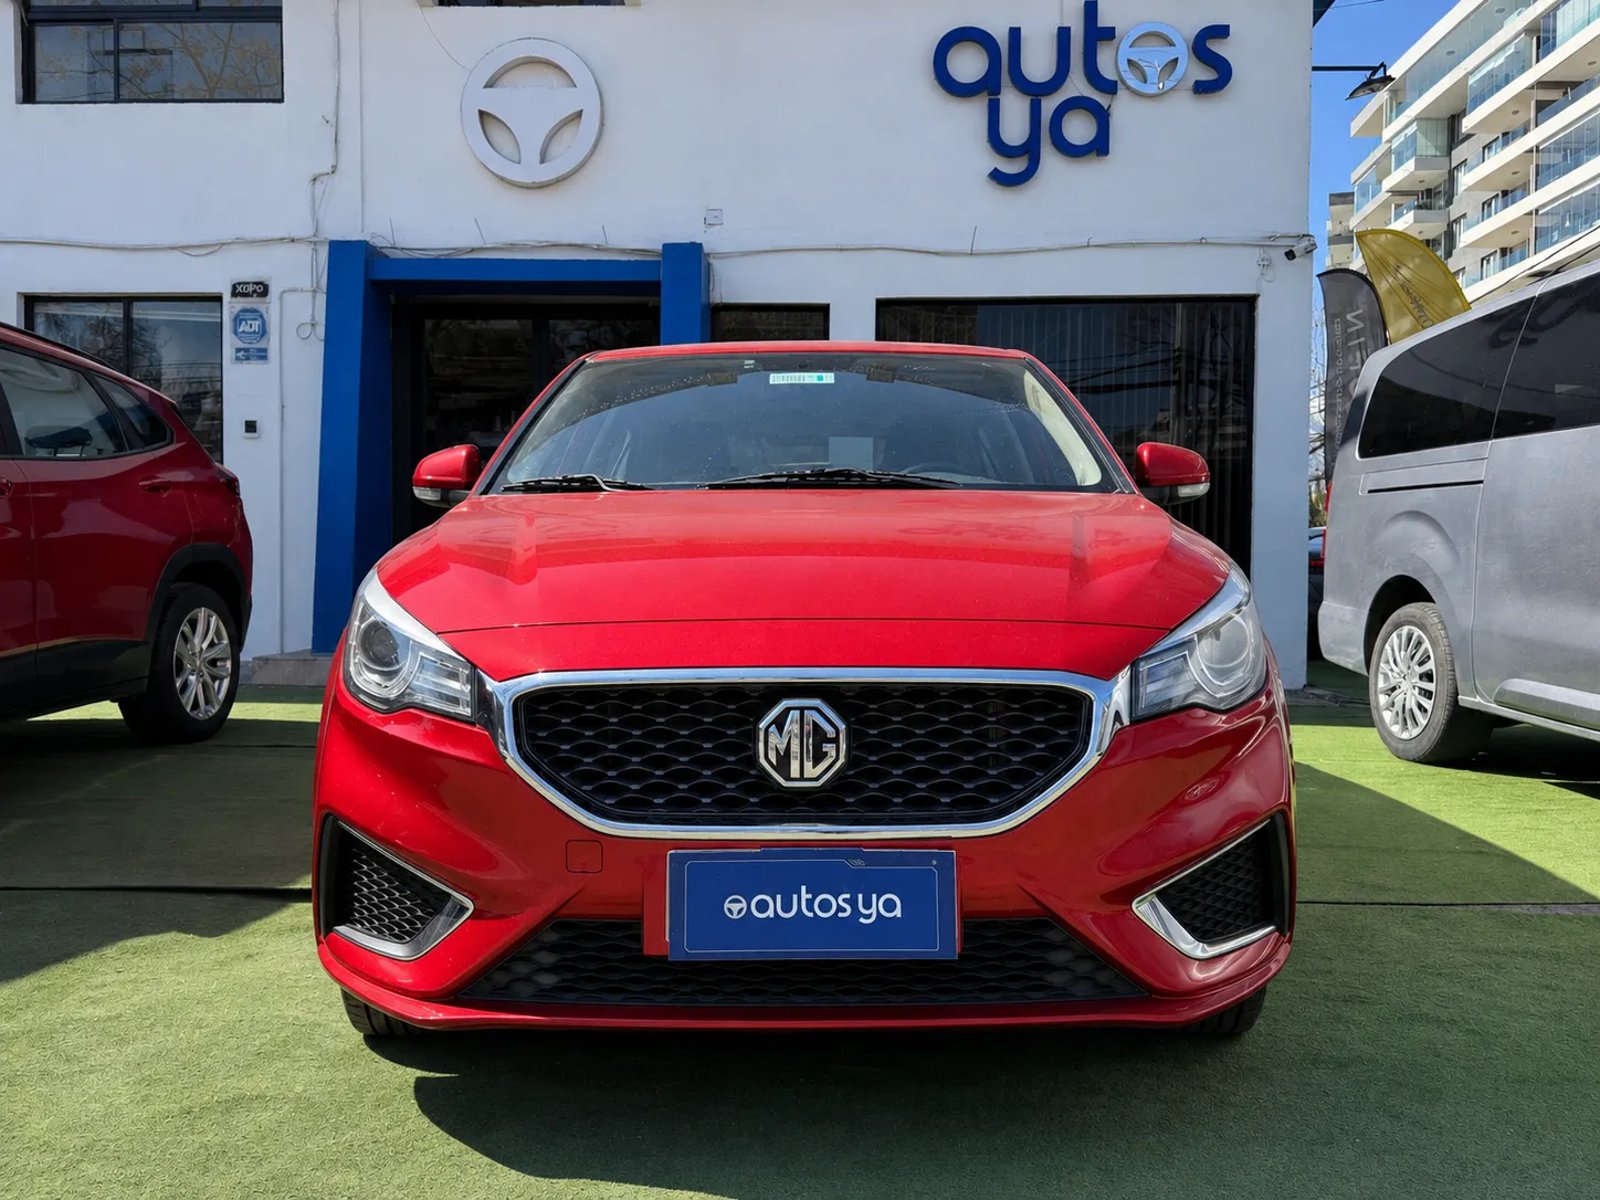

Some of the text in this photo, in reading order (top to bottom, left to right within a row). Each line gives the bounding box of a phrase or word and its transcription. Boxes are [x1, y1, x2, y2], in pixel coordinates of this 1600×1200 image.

[987, 95, 1110, 187] ya
[239, 320, 260, 333] ADT
[768, 710, 836, 778] MG
[750, 885, 902, 924] autos ya
